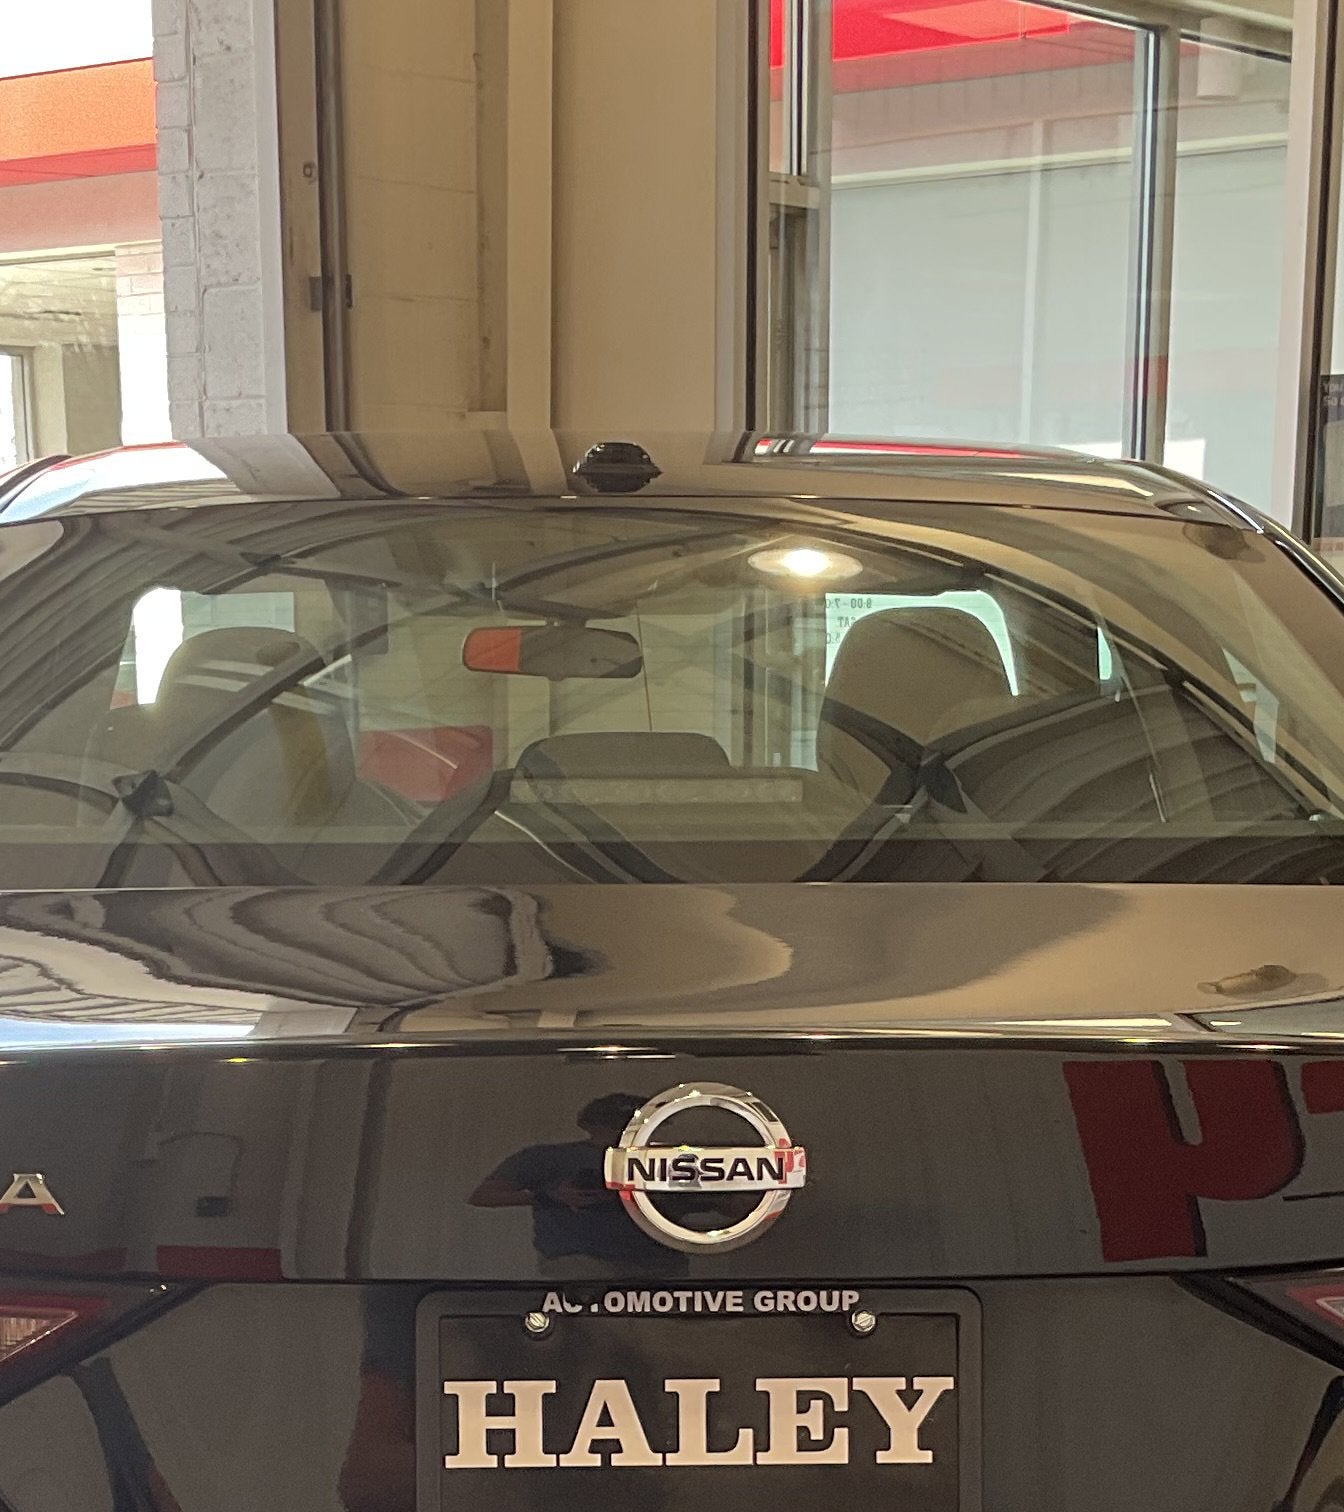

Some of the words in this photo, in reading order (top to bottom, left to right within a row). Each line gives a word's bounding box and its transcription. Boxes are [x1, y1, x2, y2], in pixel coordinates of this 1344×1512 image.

[627, 1155, 786, 1182] NISSAN
[753, 1289, 860, 1313] GROUP
[443, 1376, 955, 1468] HALEY
